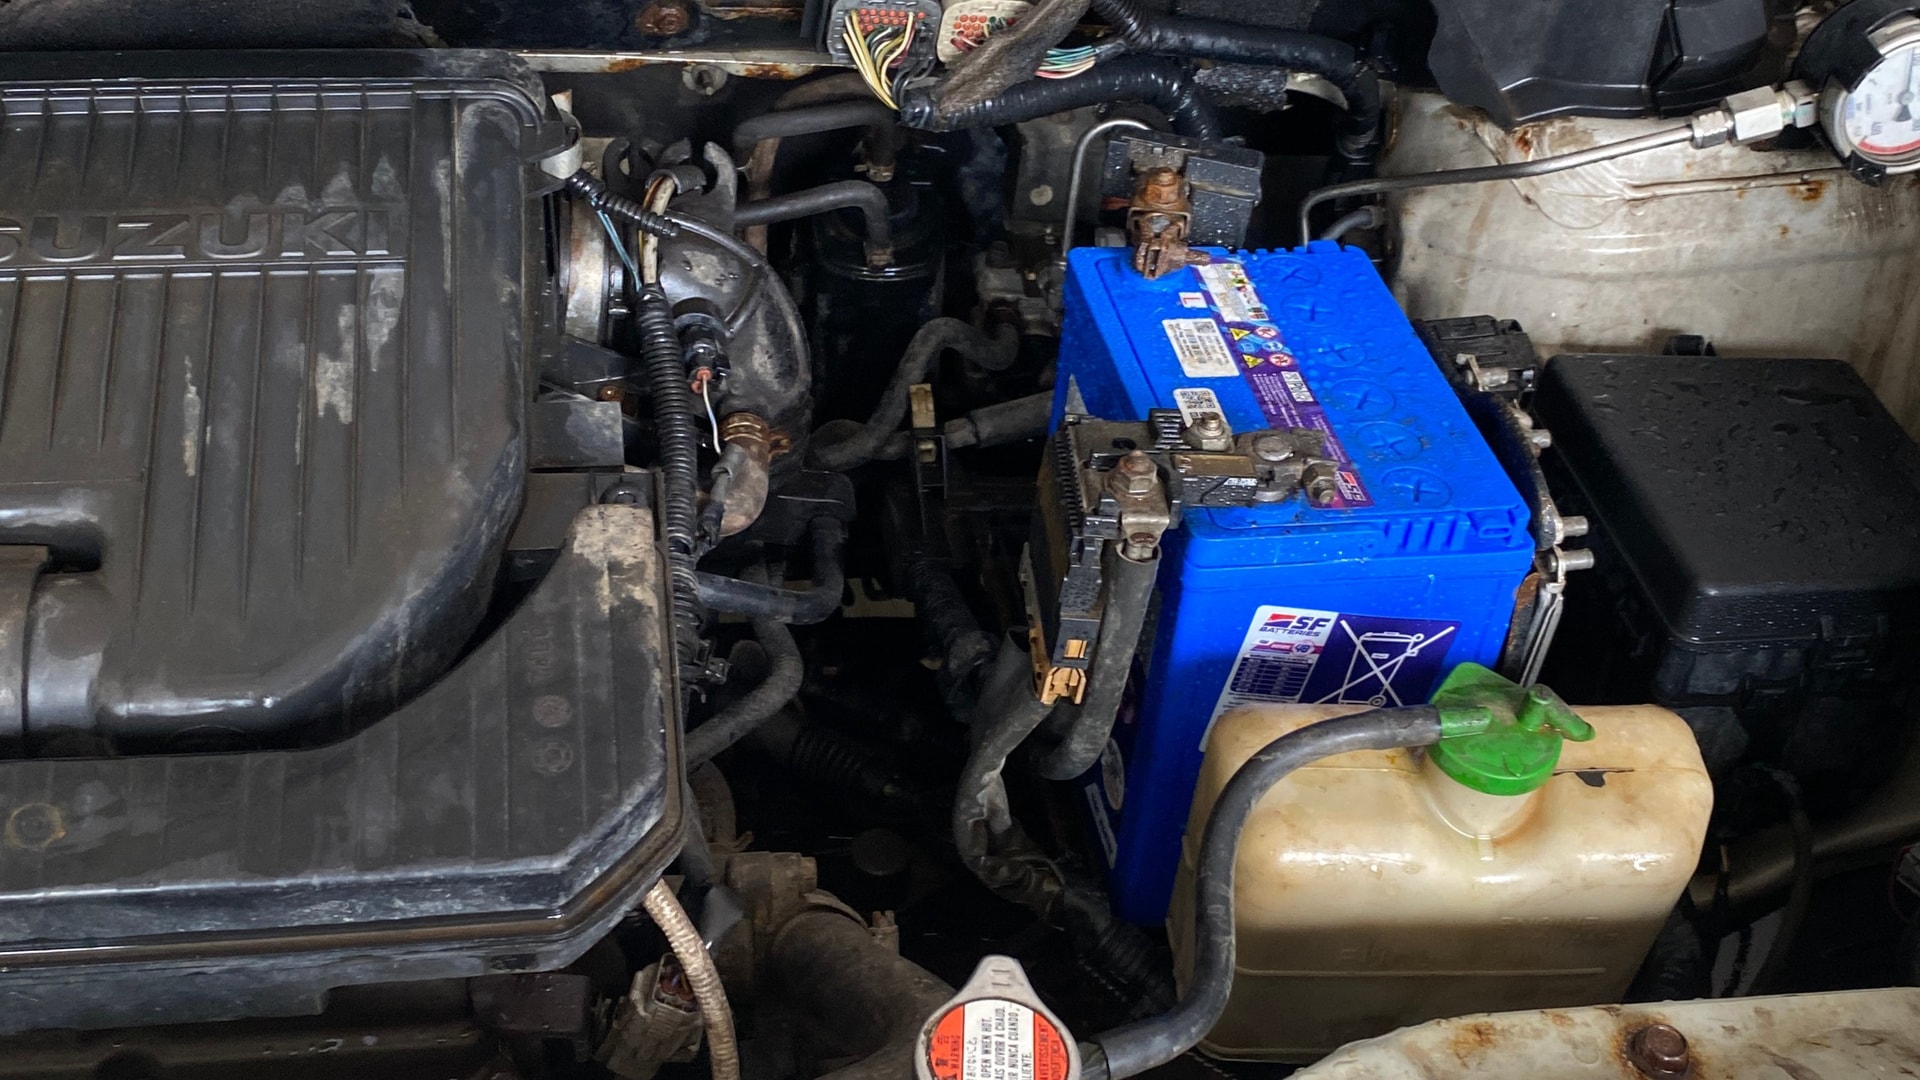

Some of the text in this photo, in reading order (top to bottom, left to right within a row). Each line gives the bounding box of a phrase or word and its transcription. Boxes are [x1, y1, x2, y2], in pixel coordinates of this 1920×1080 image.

[1258, 626, 1322, 637] BATTERIES
[1291, 615, 1332, 631] SF
[950, 1034, 960, 1070] WARNING
[981, 1016, 992, 1079] OPEN WHEN HOT.
[994, 1041, 1005, 1066] OUVRIR
[1008, 1044, 1019, 1069] NUNCA
[1021, 1052, 1032, 1080] LIENTE.
